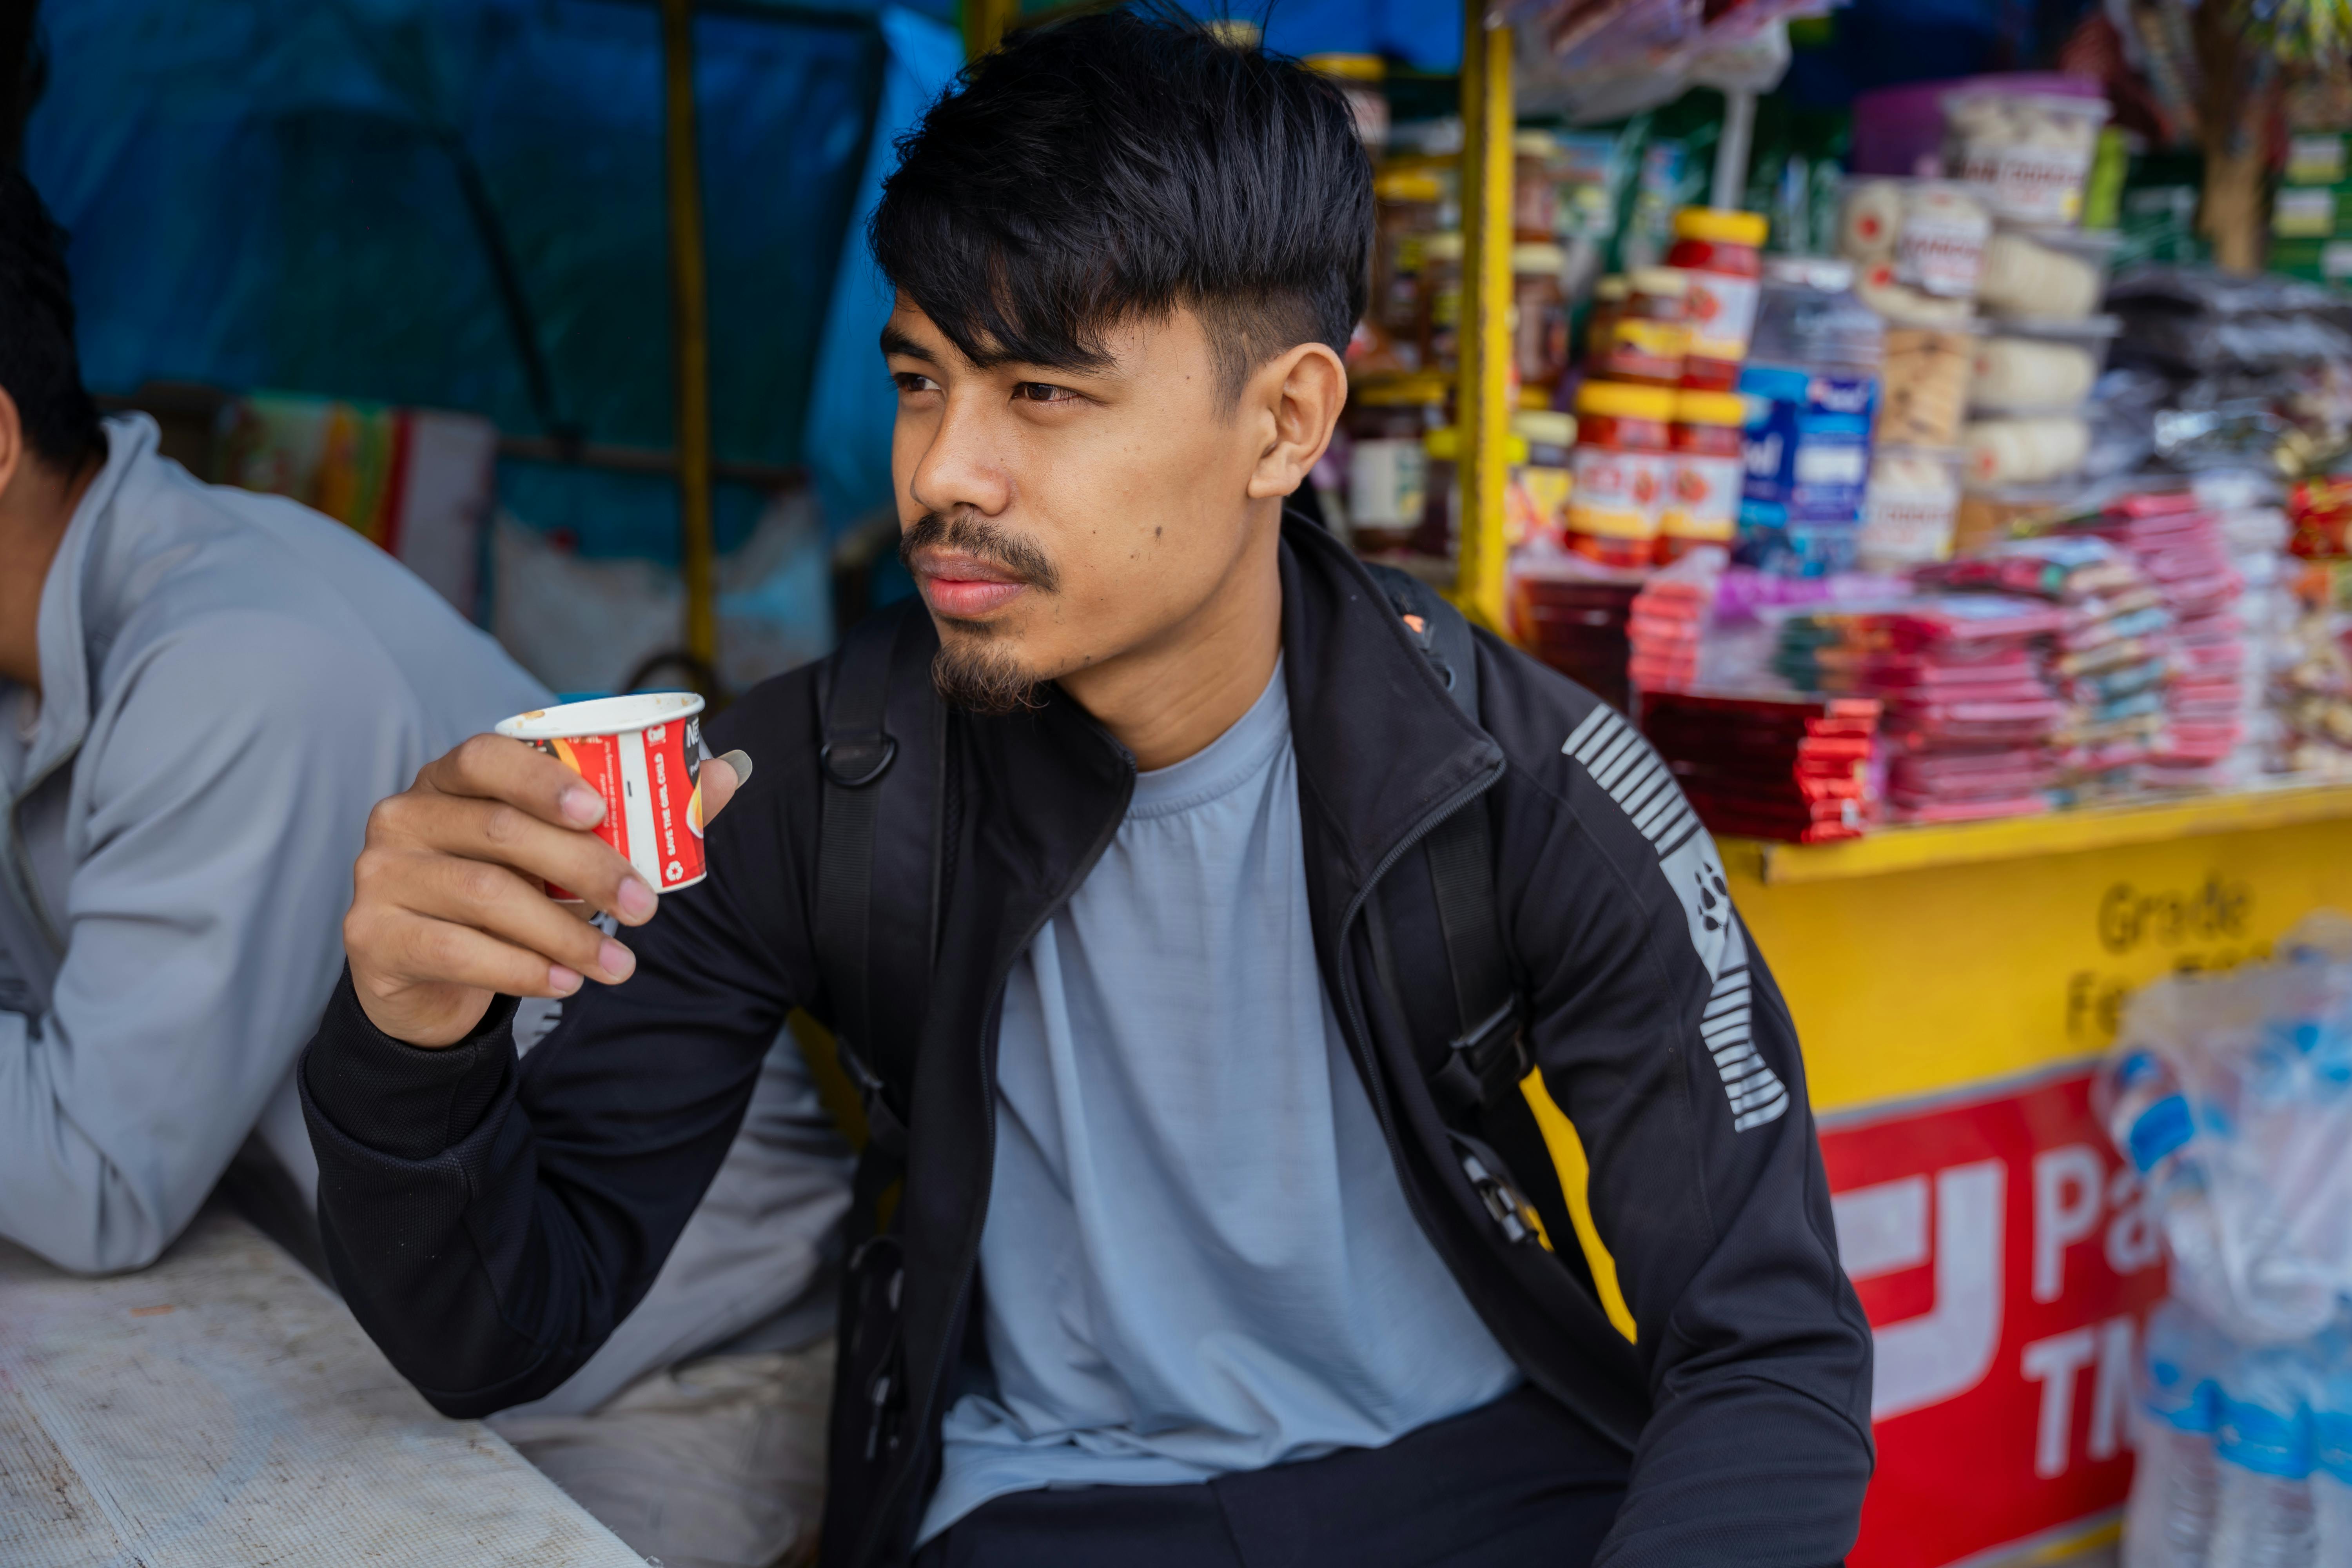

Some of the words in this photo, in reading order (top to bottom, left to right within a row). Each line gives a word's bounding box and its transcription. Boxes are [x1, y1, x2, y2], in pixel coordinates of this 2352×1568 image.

[686, 717, 699, 748] NE
[606, 753, 614, 784] extremely
[654, 752, 666, 784] CHILD
[599, 773, 608, 795] careful
[658, 783, 669, 808] GIRL
[662, 808, 672, 829] THE
[665, 829, 676, 856] SAVE
[2098, 869, 2254, 956] Grade
[2031, 1143, 2165, 1305] Pa
